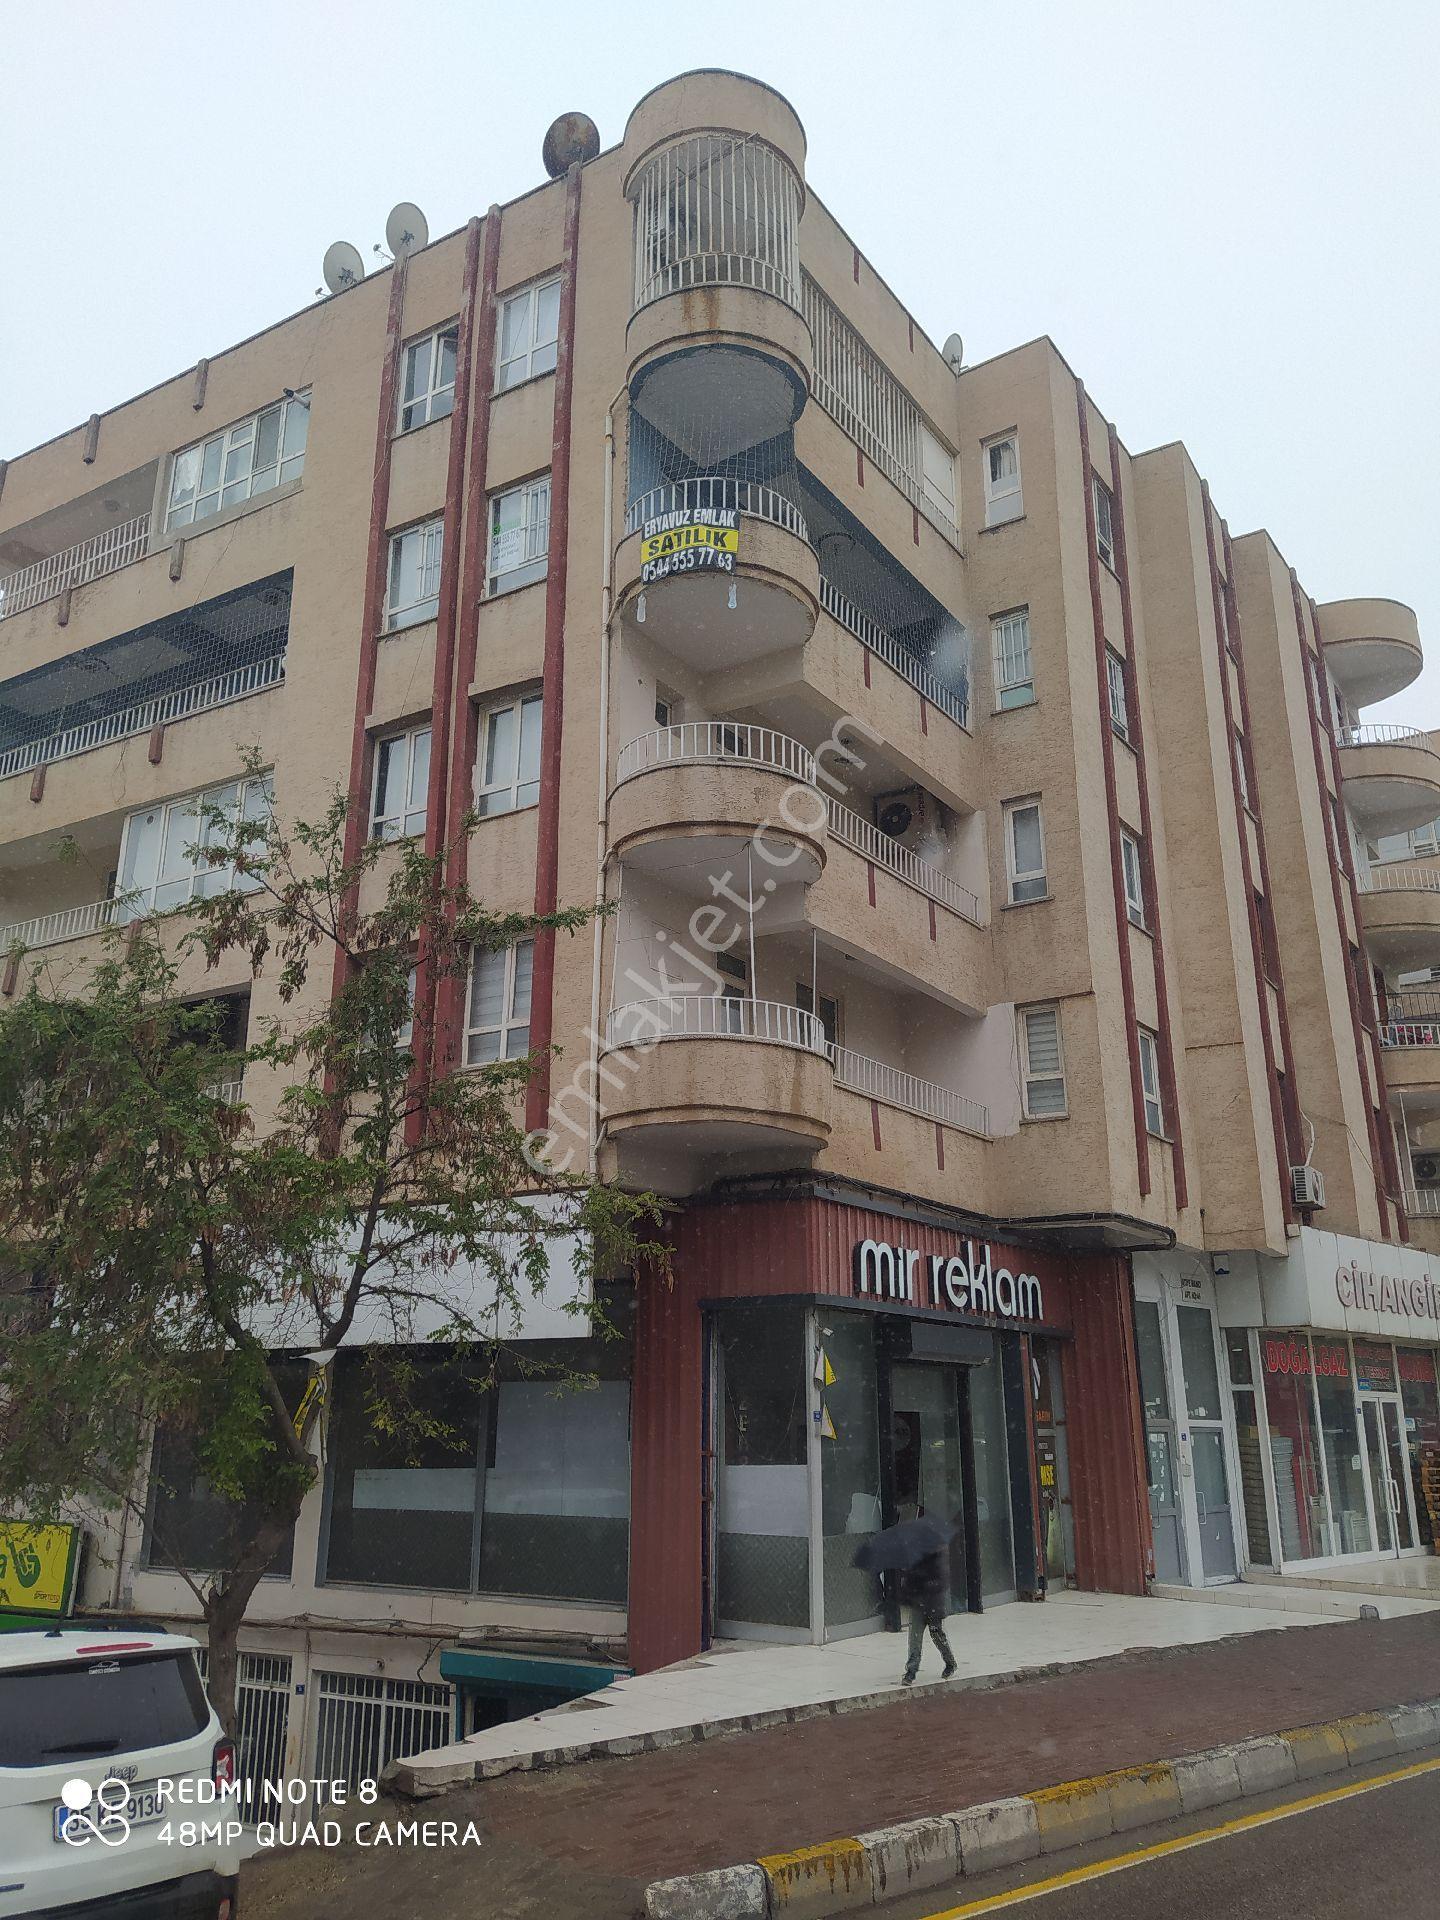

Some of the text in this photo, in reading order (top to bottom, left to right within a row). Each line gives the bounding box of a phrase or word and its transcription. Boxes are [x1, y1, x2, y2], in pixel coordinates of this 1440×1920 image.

[644, 508, 736, 539] ERYAVUZ EMLAK
[648, 529, 728, 556] SATILIK
[642, 546, 733, 582] 0544 555 77 63
[858, 1238, 1044, 1321] mir reklam
[1265, 1335, 1349, 1377] DOĞALGAZ
[104, 1765, 138, 1782] Jeep
[126, 1791, 165, 1820] 9130
